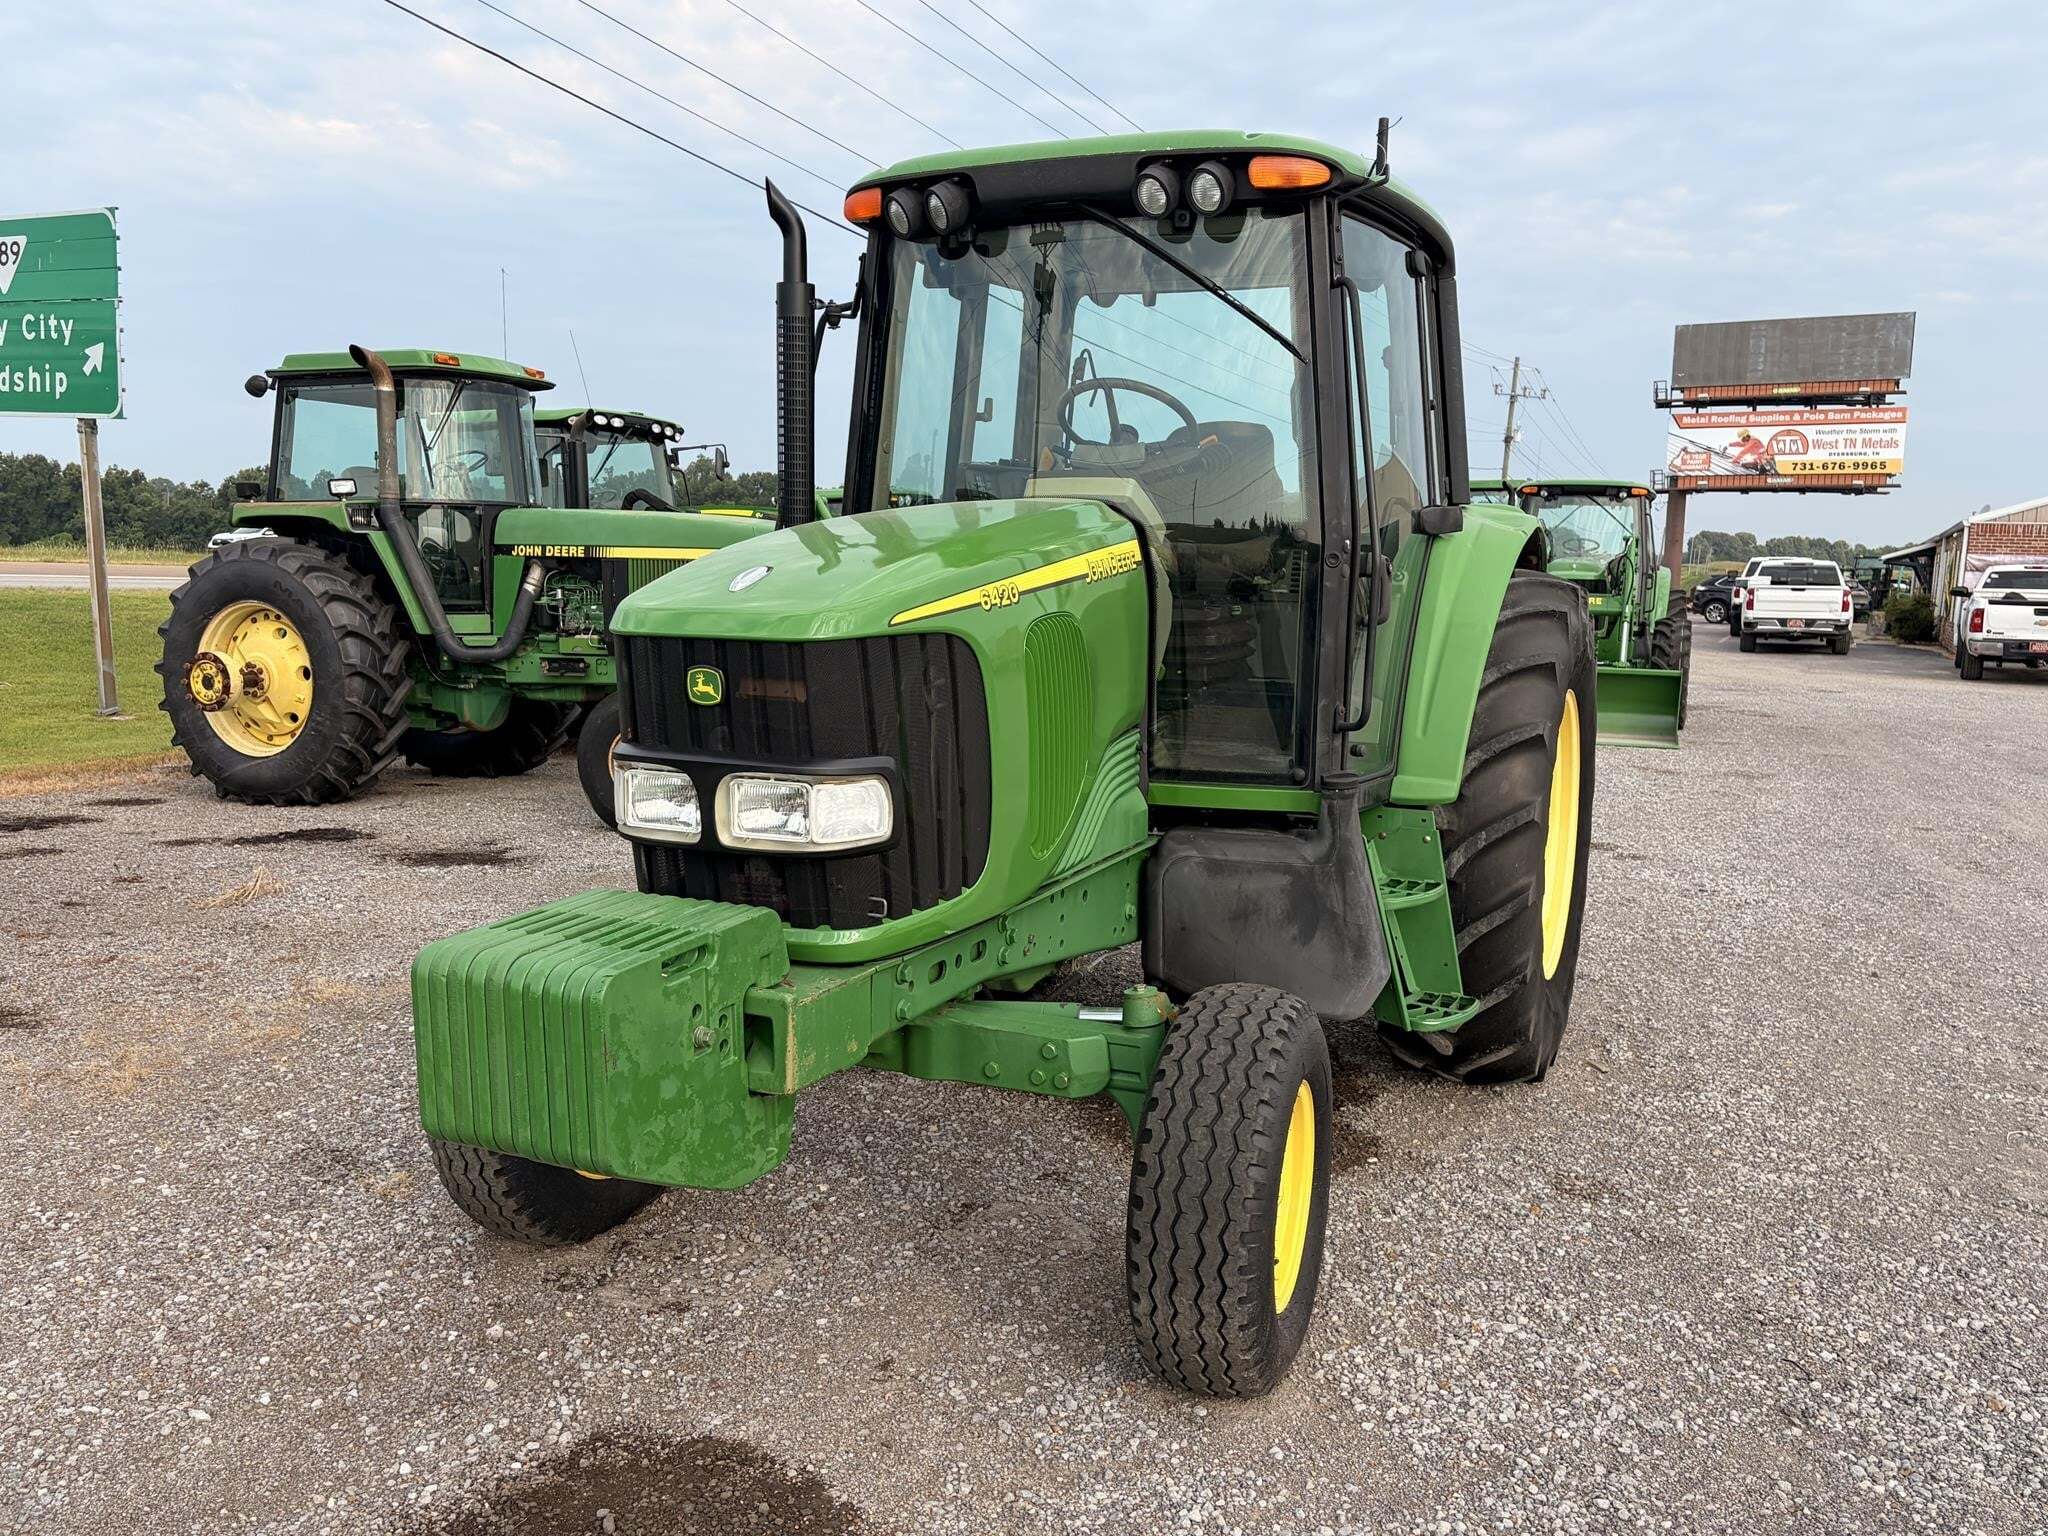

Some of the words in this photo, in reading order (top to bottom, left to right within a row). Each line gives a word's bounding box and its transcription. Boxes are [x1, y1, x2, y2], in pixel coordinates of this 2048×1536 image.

[22, 313, 74, 346] City
[1682, 415, 1709, 424] Metal
[1710, 414, 1747, 425] Roofing
[1748, 413, 1790, 425] Supplies
[1792, 413, 1800, 421] &
[1827, 411, 1851, 420] Barn
[1853, 410, 1903, 421] Packages
[1815, 428, 1843, 436] Weather
[1859, 427, 1880, 435] Storm
[1811, 438, 1839, 450] West
[1842, 438, 1858, 449] TN
[1861, 436, 1900, 449] Metals
[1791, 461, 1887, 471] 731-676-9965
[511, 545, 542, 556] JOHN
[545, 545, 585, 557] DEERE
[980, 582, 1019, 611] 6420
